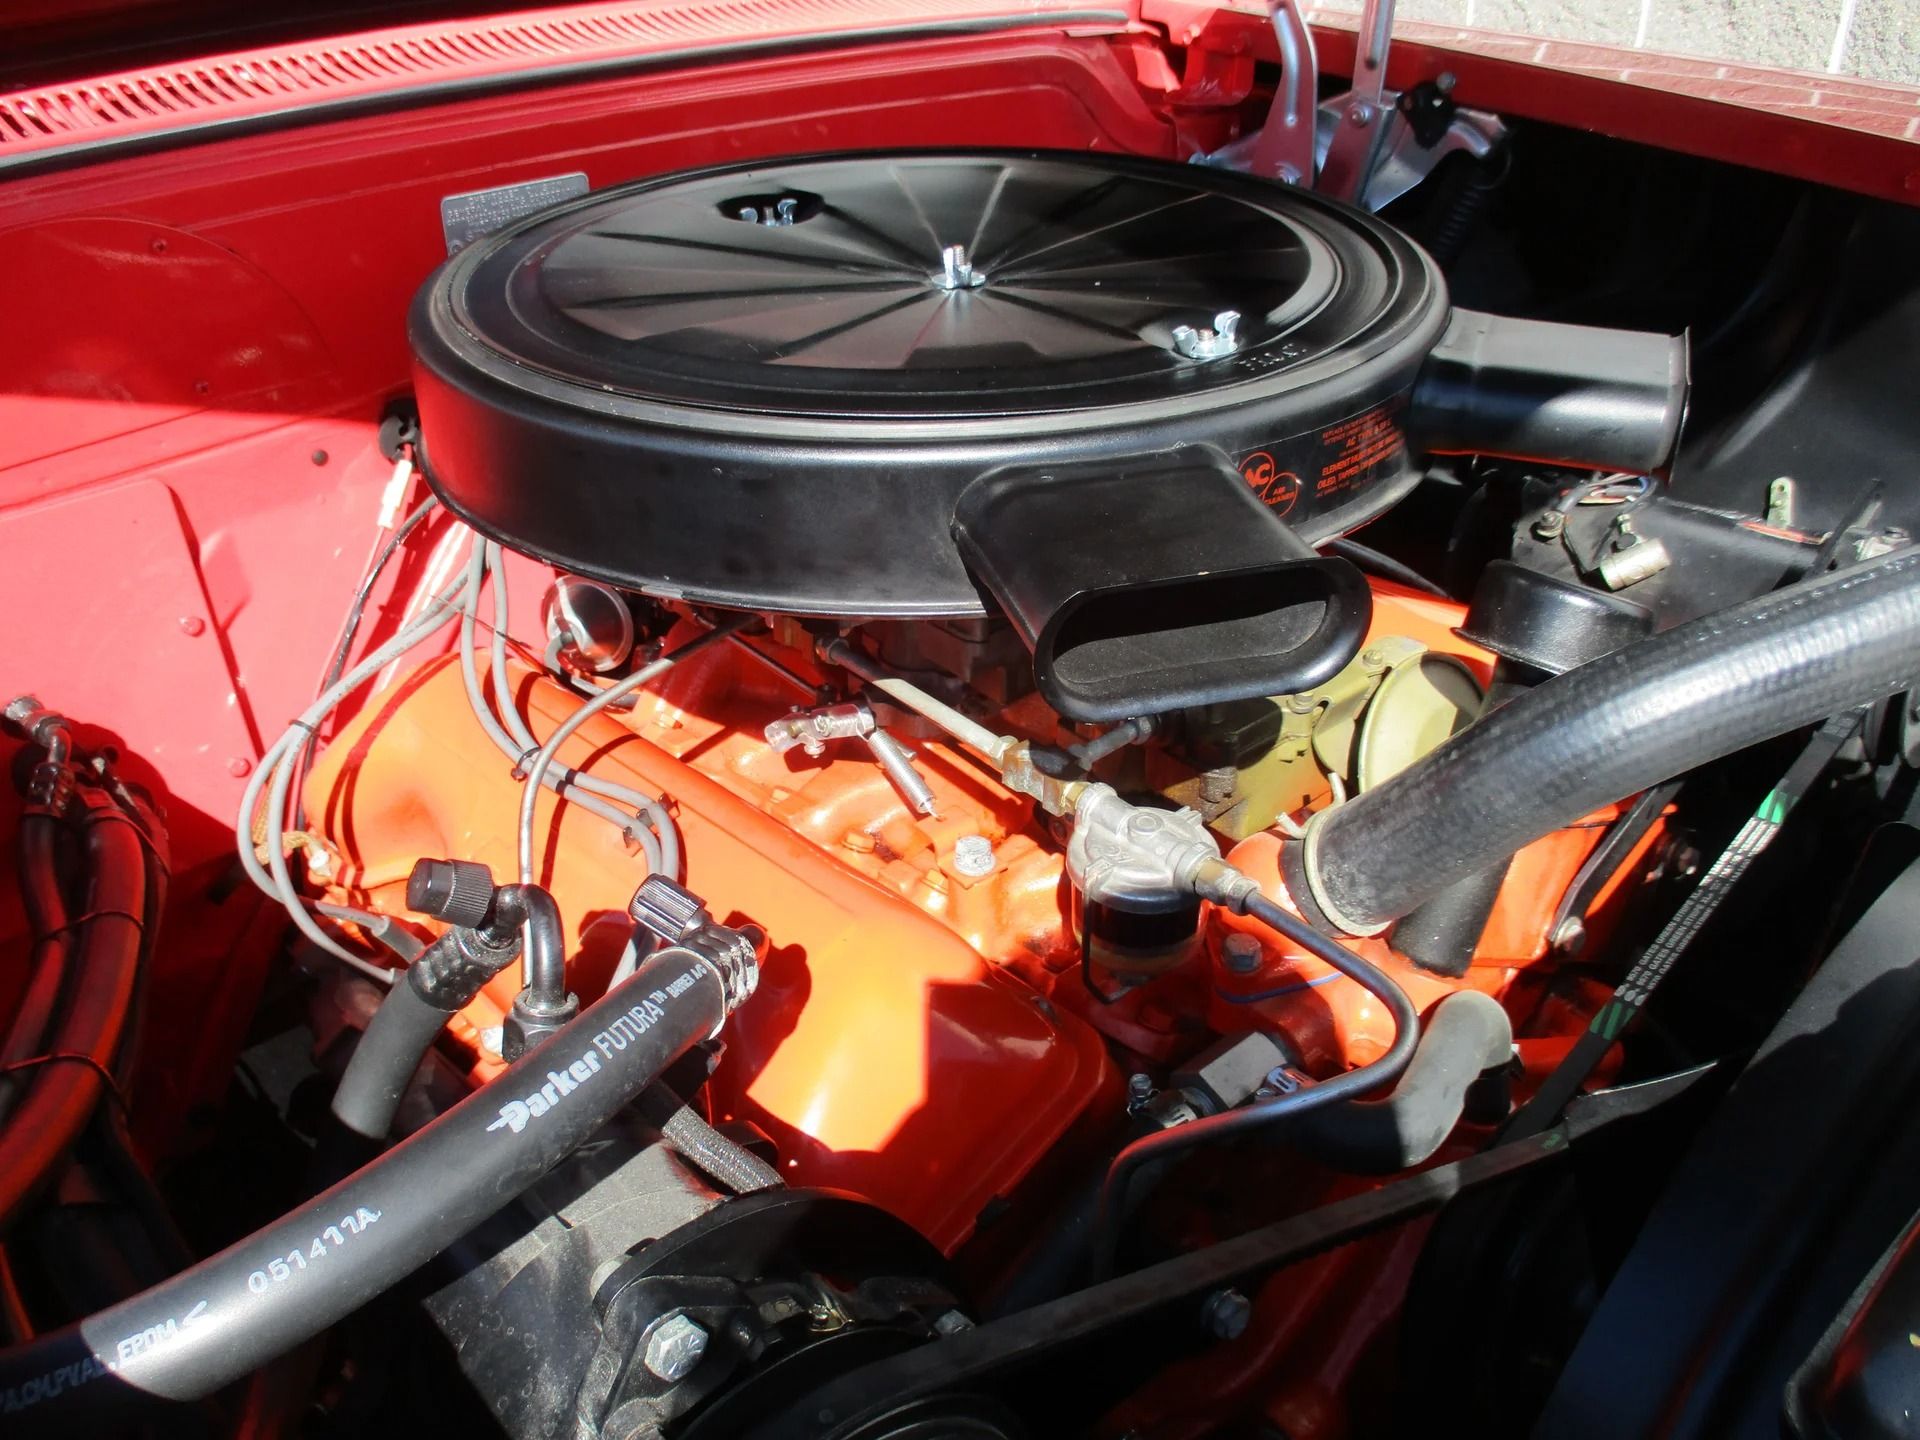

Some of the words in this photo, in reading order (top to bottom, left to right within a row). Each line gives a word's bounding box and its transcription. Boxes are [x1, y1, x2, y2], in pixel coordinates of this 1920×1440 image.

[1245, 463, 1270, 488] AC
[1322, 459, 1349, 476] ELEMENT
[1638, 944, 1659, 966] GATES
[1655, 922, 1677, 945] GREEN
[1673, 899, 1695, 922] STRIPE
[1649, 948, 1669, 971] GATES
[1665, 925, 1687, 949] GREEN
[1683, 903, 1705, 927] STRIPE
[486, 1049, 601, 1133] Parker
[665, 972, 696, 999] BARRIER
[694, 963, 708, 979] A/C
